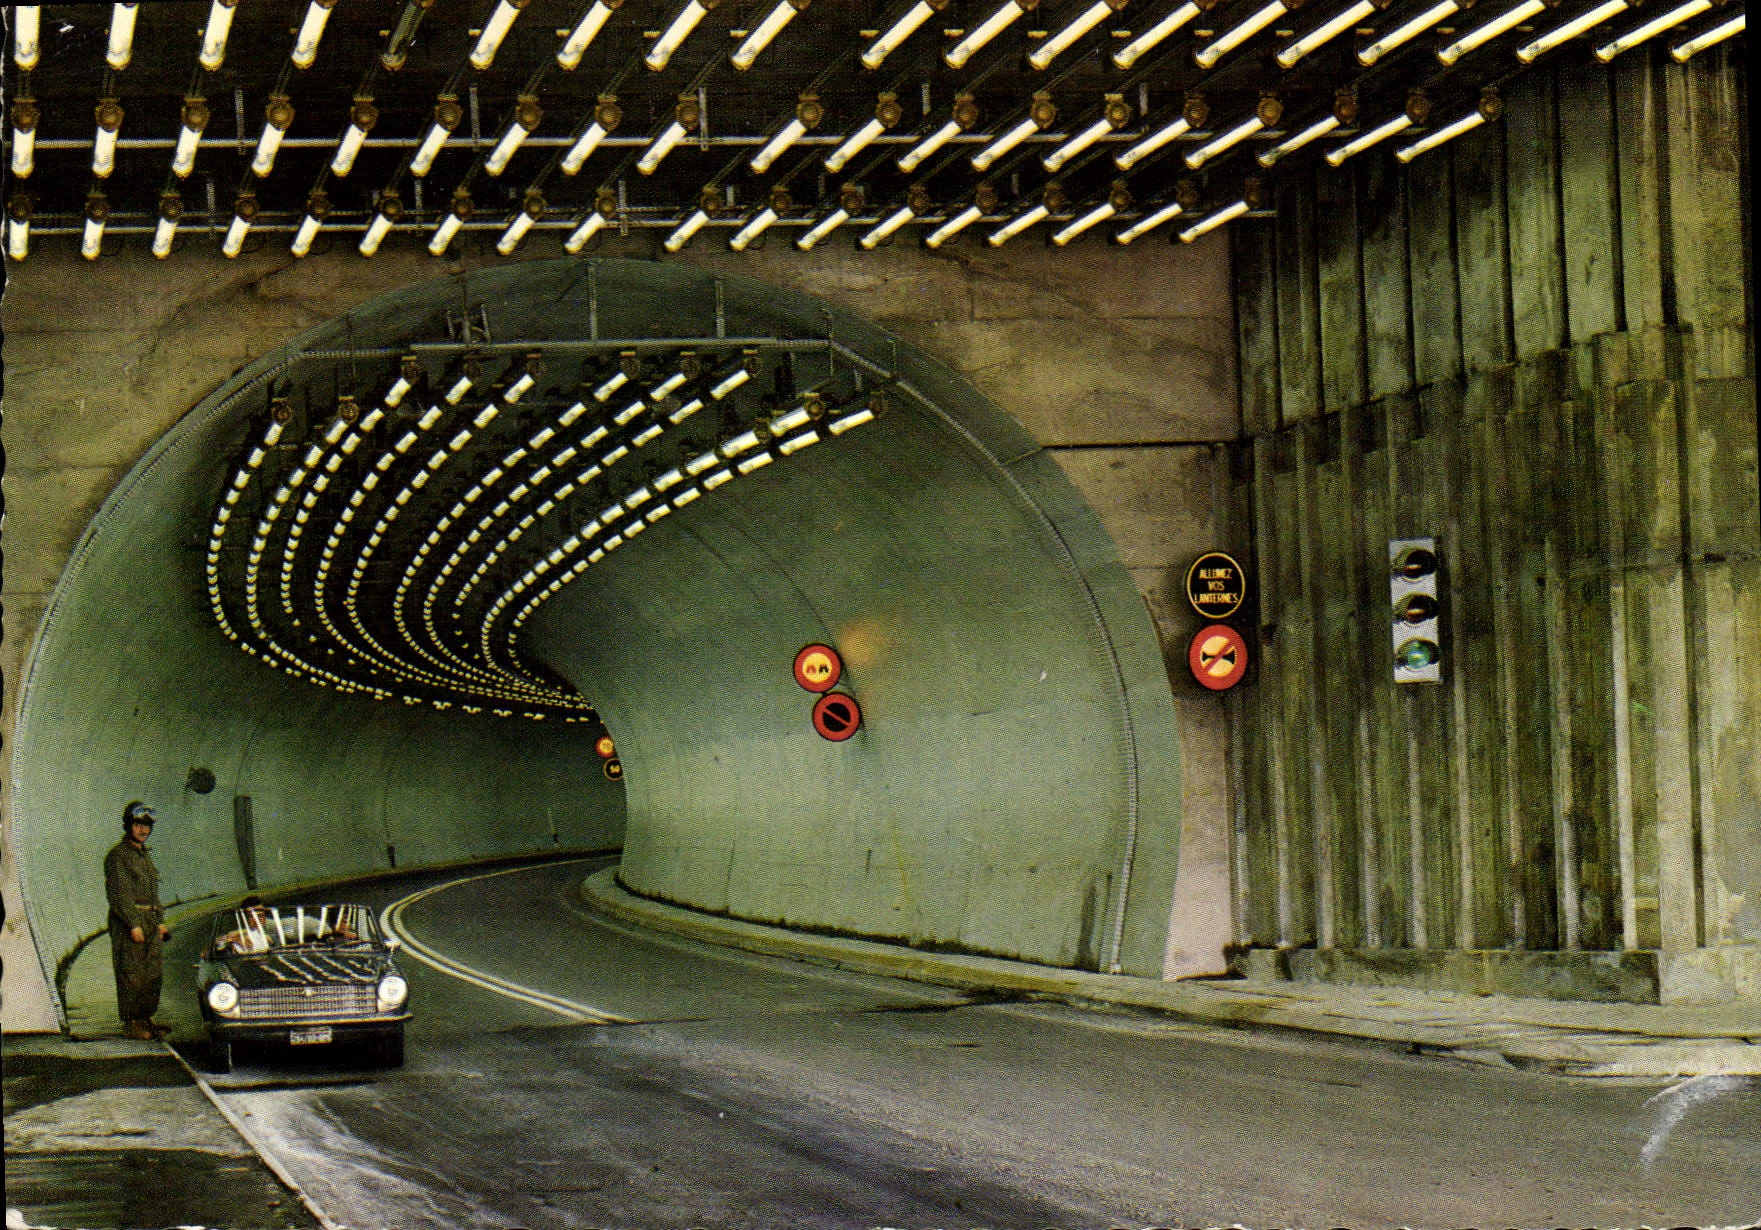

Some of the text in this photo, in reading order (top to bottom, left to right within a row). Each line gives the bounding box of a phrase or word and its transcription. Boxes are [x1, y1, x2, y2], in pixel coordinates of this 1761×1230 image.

[1199, 568, 1233, 579] ALLUMEZ
[1207, 581, 1225, 591] VOS
[1193, 593, 1239, 604] LANTERNES
